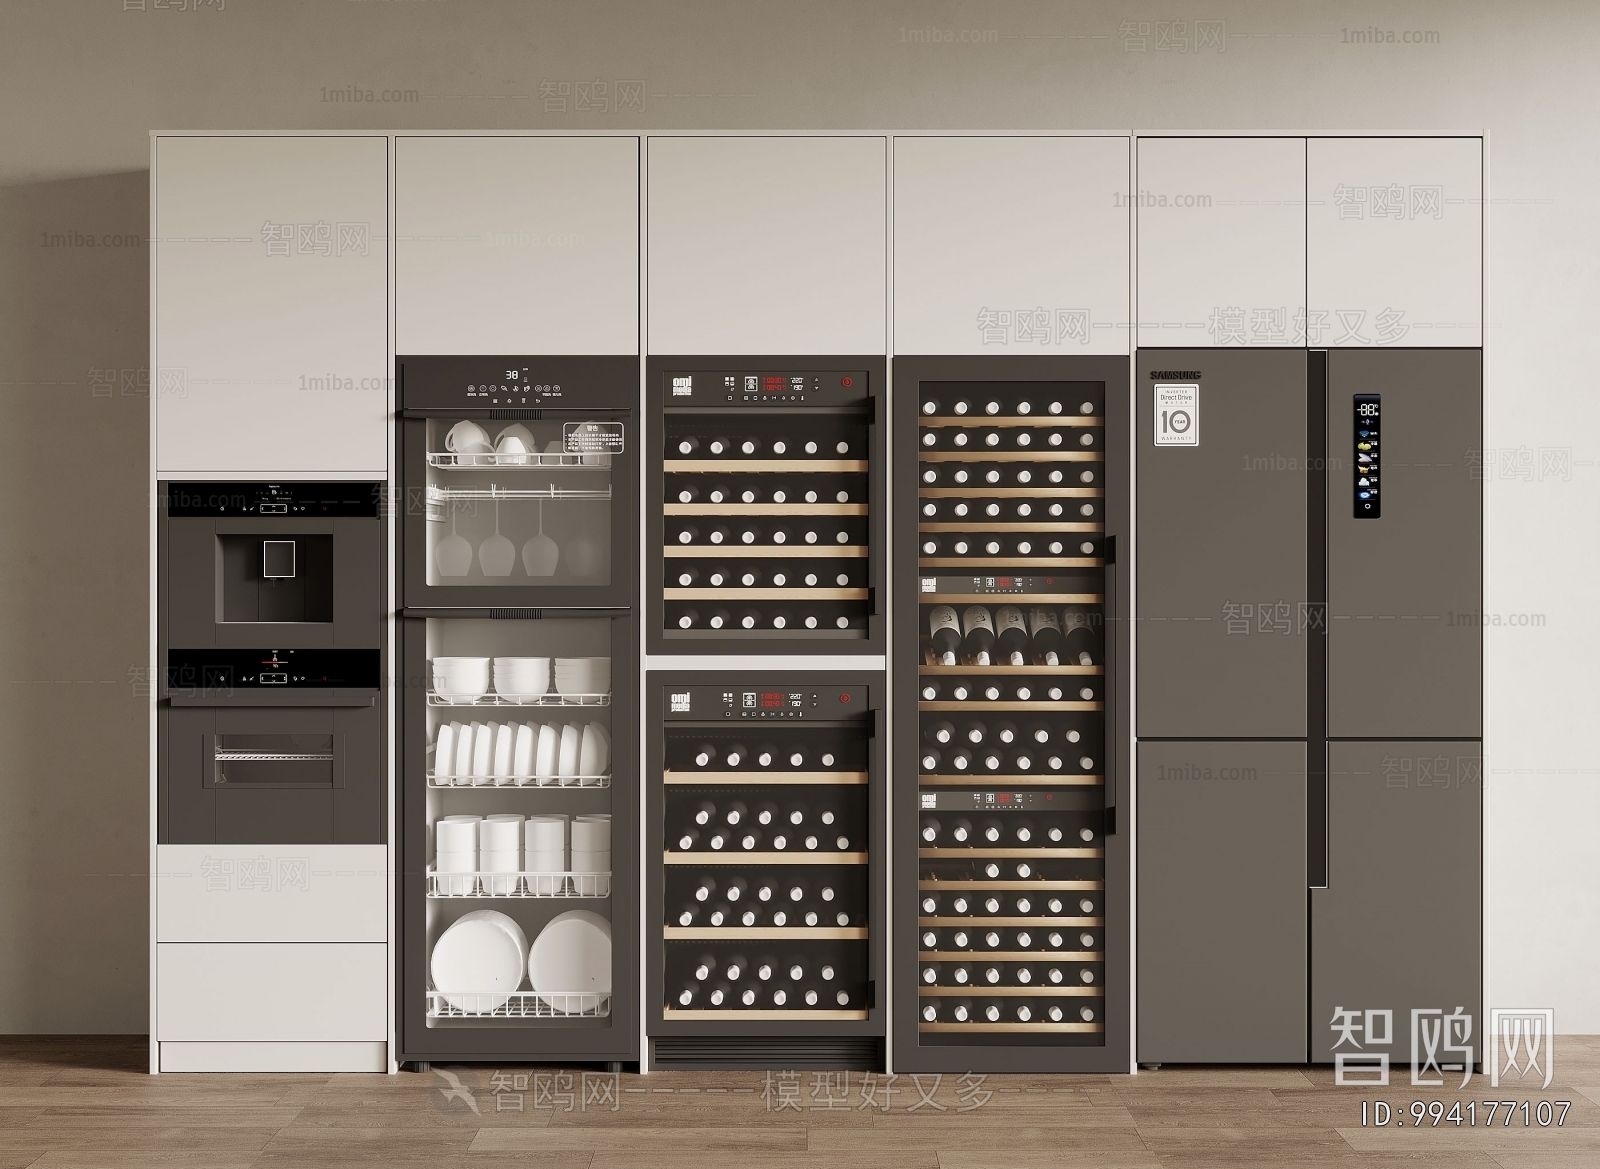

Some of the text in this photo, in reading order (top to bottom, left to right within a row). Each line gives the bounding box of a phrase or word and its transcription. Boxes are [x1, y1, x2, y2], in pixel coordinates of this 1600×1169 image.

[505, 370, 518, 380] 38
[1149, 370, 1202, 380] SAMSUNG
[1162, 410, 1191, 434] 10
